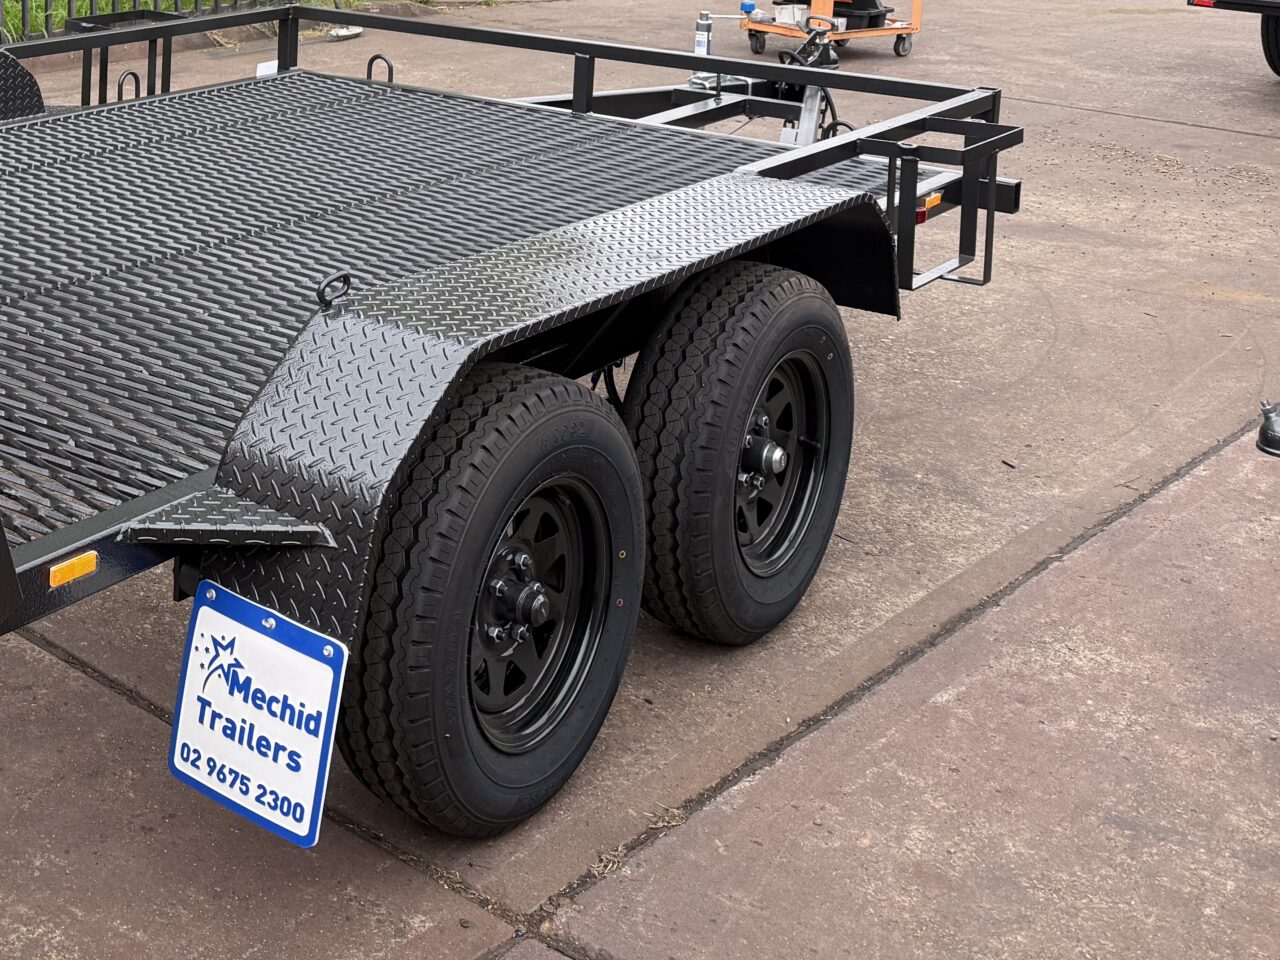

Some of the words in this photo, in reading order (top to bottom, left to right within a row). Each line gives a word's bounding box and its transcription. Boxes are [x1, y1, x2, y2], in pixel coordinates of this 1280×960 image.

[196, 695, 303, 773] Trailers
[228, 668, 323, 738] Mechid
[180, 742, 202, 770] 02
[206, 756, 251, 797] 9675
[255, 783, 305, 825] 2300
